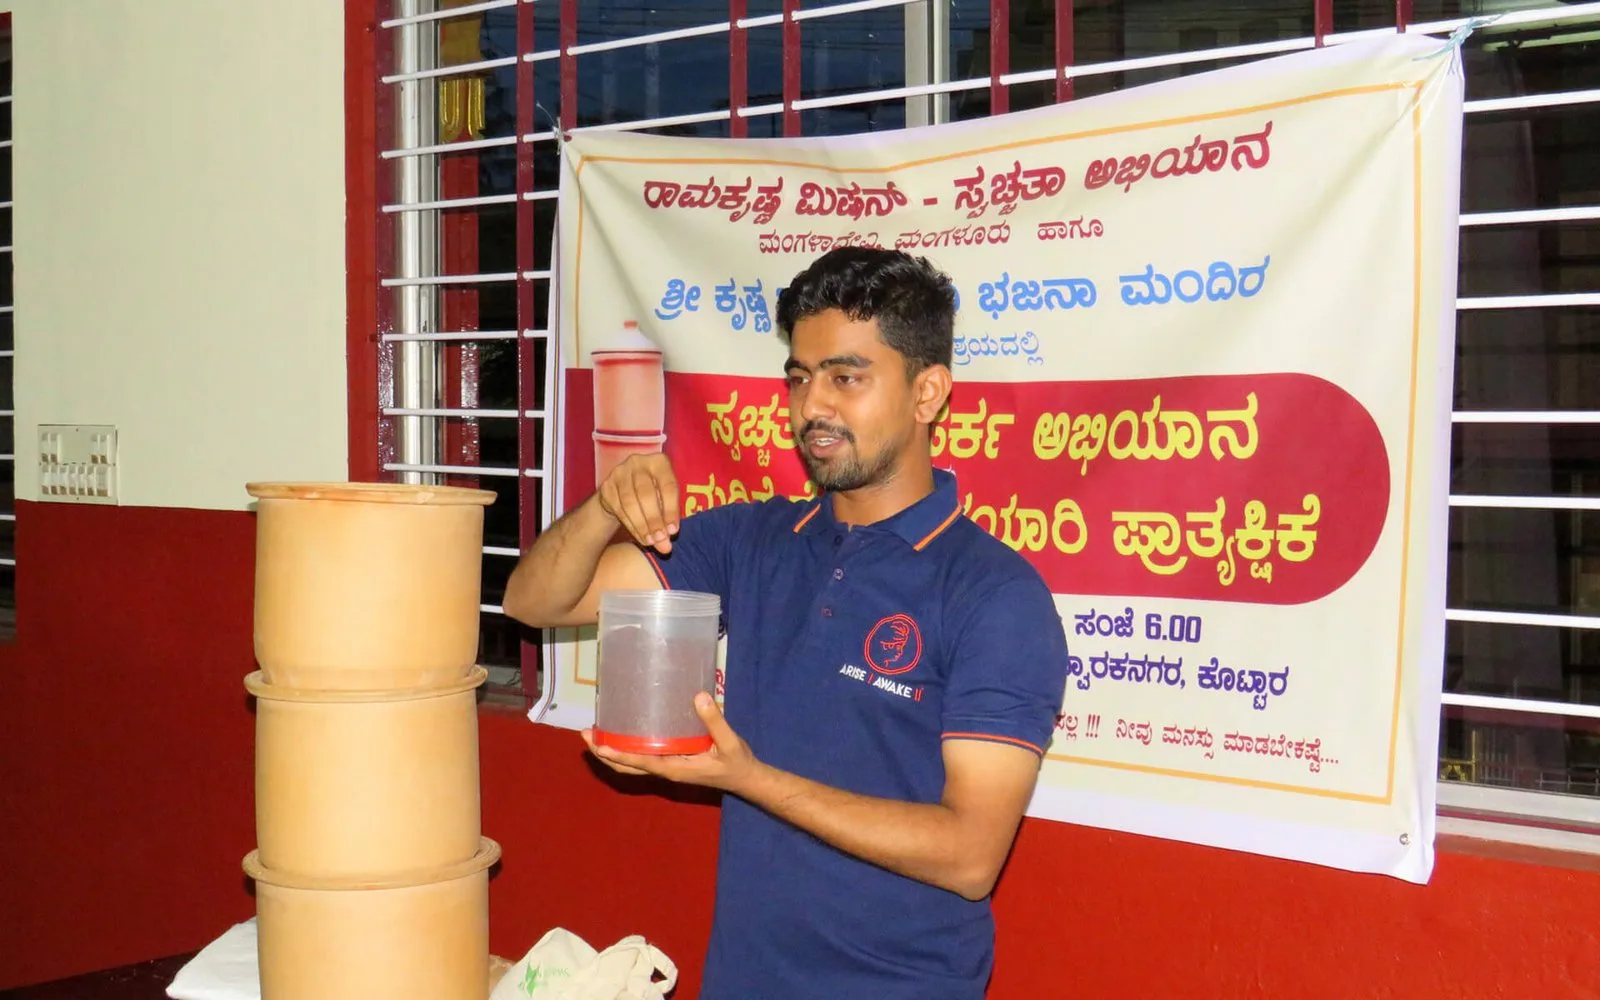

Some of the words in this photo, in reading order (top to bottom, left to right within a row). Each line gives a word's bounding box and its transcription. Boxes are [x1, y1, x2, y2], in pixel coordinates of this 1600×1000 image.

[643, 176, 783, 224] ರಾಮಕೃಷ್ಣ
[795, 181, 908, 221] ಮಿಷನ್
[1084, 121, 1274, 193] ಅಭಿಯಾನ
[895, 221, 1011, 250] ಮಂಗಳೂರು
[1038, 215, 1104, 242] ಹಾಗೂ
[654, 278, 701, 321] ಶ್ರೀ
[714, 277, 772, 333] ಕೃಷ್ಣ
[978, 272, 1098, 319] ಭಜನಾ
[1119, 255, 1271, 307] ಮಂದಿರ
[1033, 392, 1258, 476] ಅಭಿಯಾನ
[1111, 493, 1321, 586] ಪ್ರಾತ್ಯಕ್ಷಿಕೆ
[1074, 607, 1134, 638] ಸಂಜೆ
[1145, 613, 1202, 643] 6.00
[839, 663, 867, 681] ARISE
[872, 676, 913, 699] AWAKE
[1198, 657, 1289, 711] ಕೊಟ್ಟಾರ
[1116, 718, 1153, 746] ನೀವು
